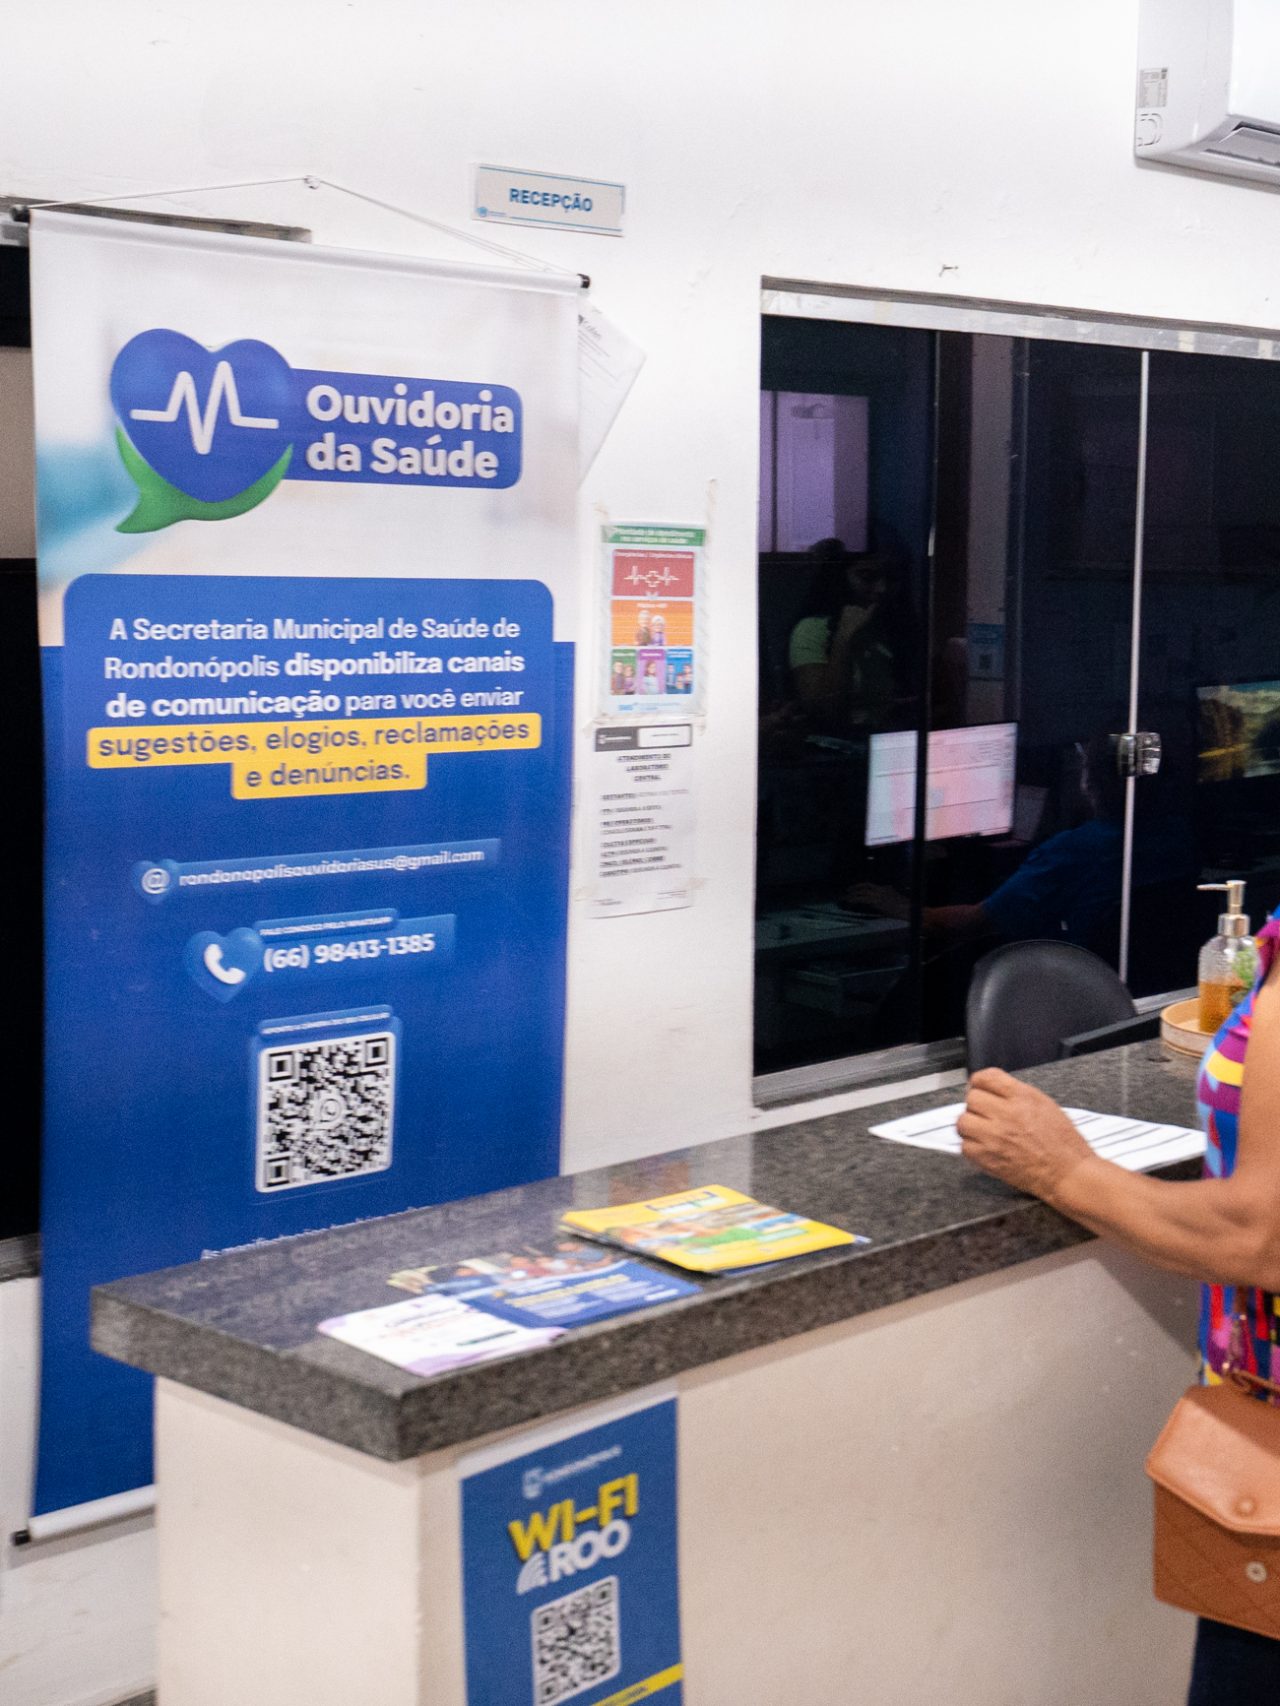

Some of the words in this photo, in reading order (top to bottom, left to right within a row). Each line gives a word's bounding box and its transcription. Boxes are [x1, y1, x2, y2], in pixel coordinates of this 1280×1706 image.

[508, 188, 593, 213] RECEPÇÃO
[306, 383, 515, 433] Ouvidoria
[306, 432, 361, 472] da
[371, 434, 499, 479] Saúde
[108, 618, 128, 641] A
[133, 618, 268, 641] Secretaria
[273, 617, 384, 644] Municipal
[388, 617, 418, 639] de
[421, 617, 489, 639] Saúde
[492, 617, 521, 638] de
[104, 655, 280, 682] Rondonópolis
[285, 650, 443, 682] disponibiliza
[447, 650, 526, 673] canais
[105, 692, 146, 718] de
[152, 689, 340, 718] comunicação
[345, 694, 397, 717] para
[401, 688, 456, 708] você
[460, 686, 525, 707] enviar
[99, 730, 257, 761] sugestões,
[265, 725, 367, 754] elogios,
[374, 720, 530, 746] reclamações
[246, 771, 263, 787] e
[270, 759, 410, 786] denúncias.
[263, 944, 310, 973] (66)
[314, 933, 436, 964] 98413-1385
[508, 1473, 639, 1561] WI-FI
[549, 1518, 631, 1582] ROO
